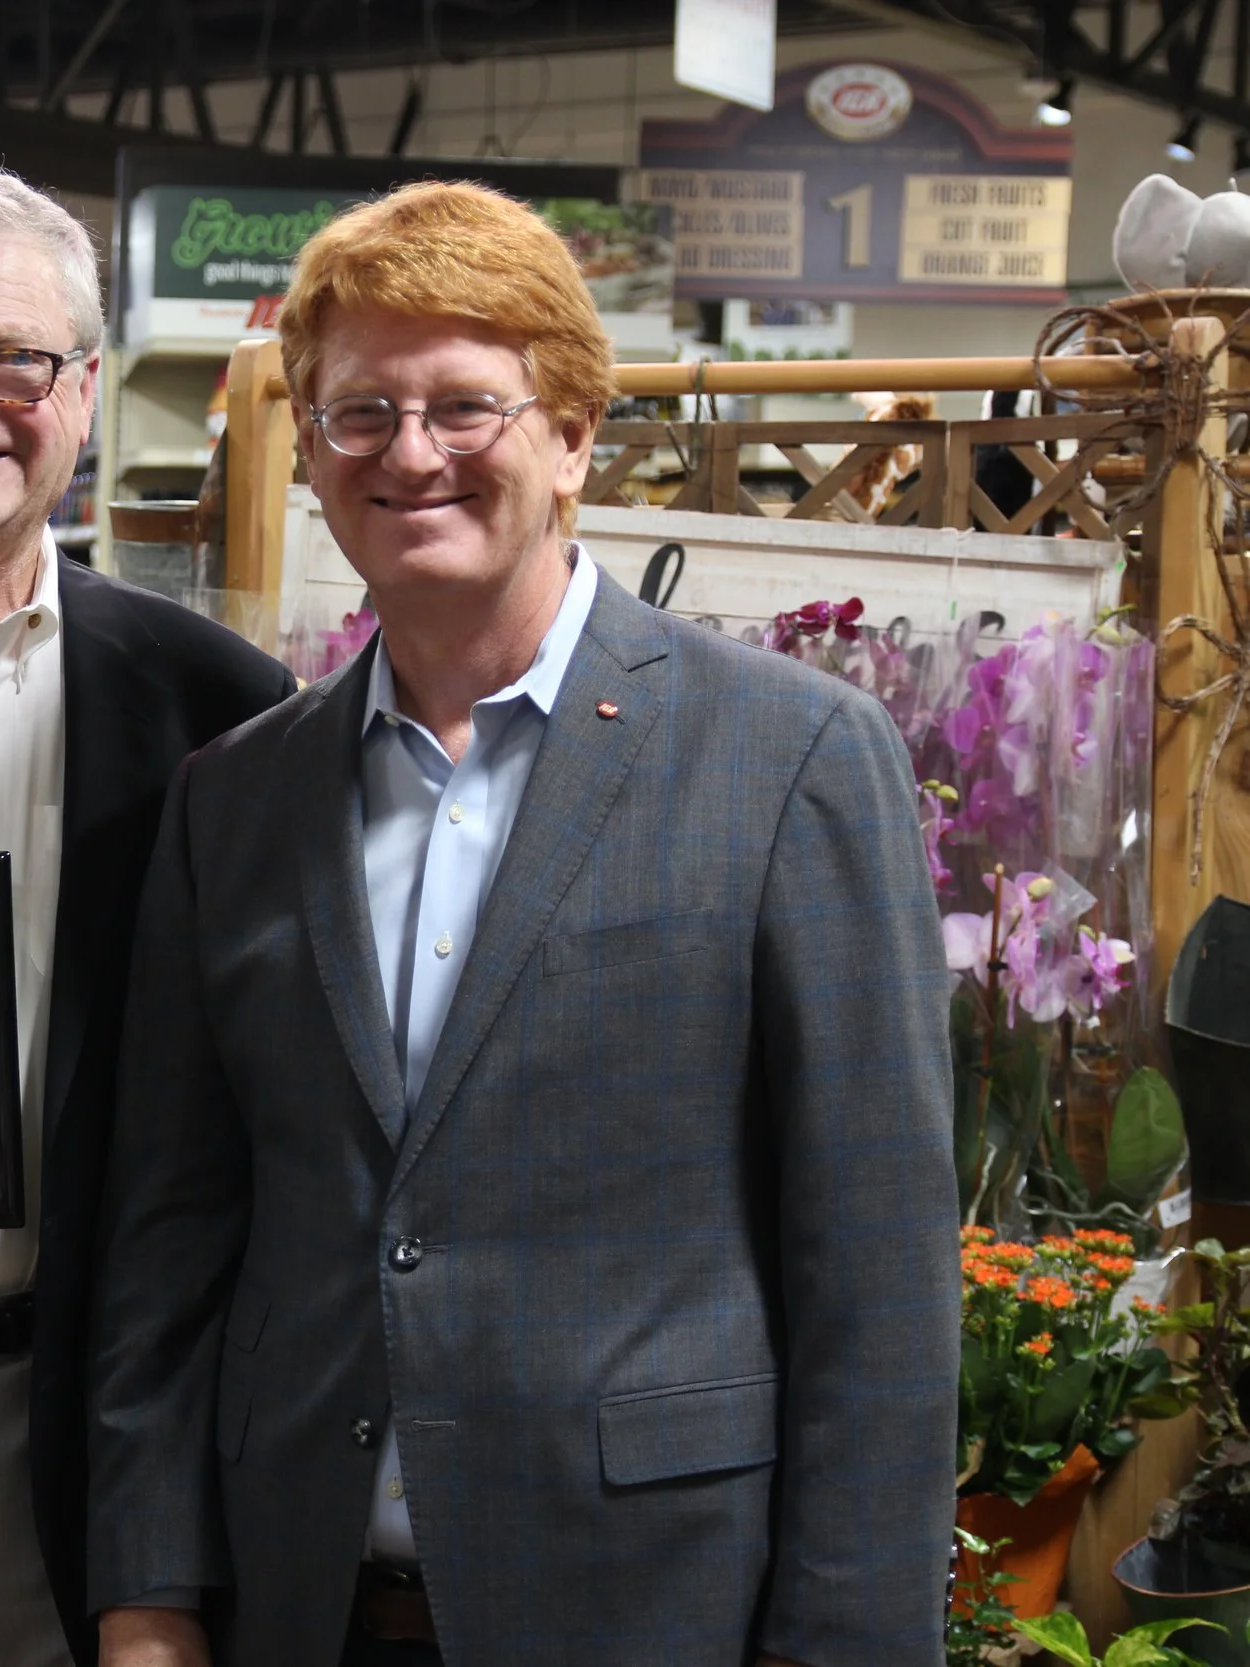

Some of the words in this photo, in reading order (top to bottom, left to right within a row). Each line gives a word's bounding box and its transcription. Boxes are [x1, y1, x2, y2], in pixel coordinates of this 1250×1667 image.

[931, 182, 978, 205] FRESH
[989, 183, 1047, 207] FRUITS
[826, 184, 874, 268] 1
[941, 217, 973, 242] CUT
[982, 218, 1028, 243] FRUIT
[922, 251, 989, 276] ORANGE
[997, 252, 1044, 277] JUICE
